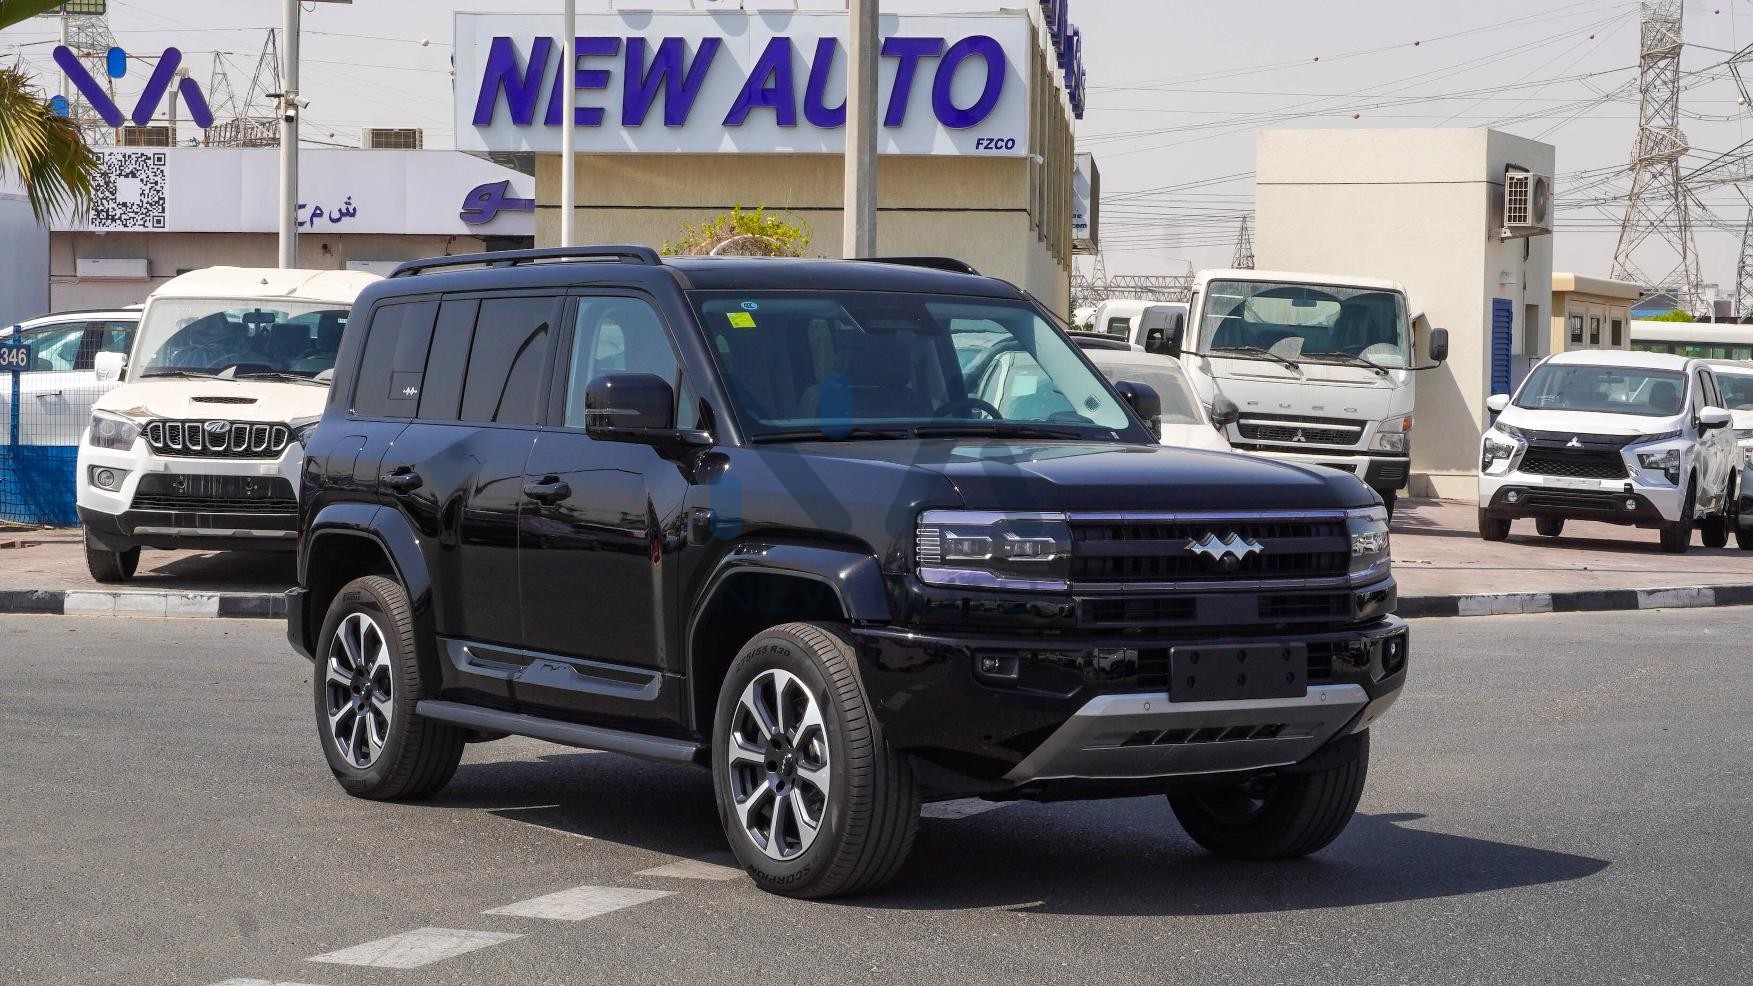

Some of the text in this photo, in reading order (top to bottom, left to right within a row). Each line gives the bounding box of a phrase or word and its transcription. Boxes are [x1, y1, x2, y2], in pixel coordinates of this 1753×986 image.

[472, 37, 723, 127] NEW
[721, 34, 1006, 129] AUTO
[975, 138, 1016, 150] FZCO
[0, 347, 27, 367] 346
